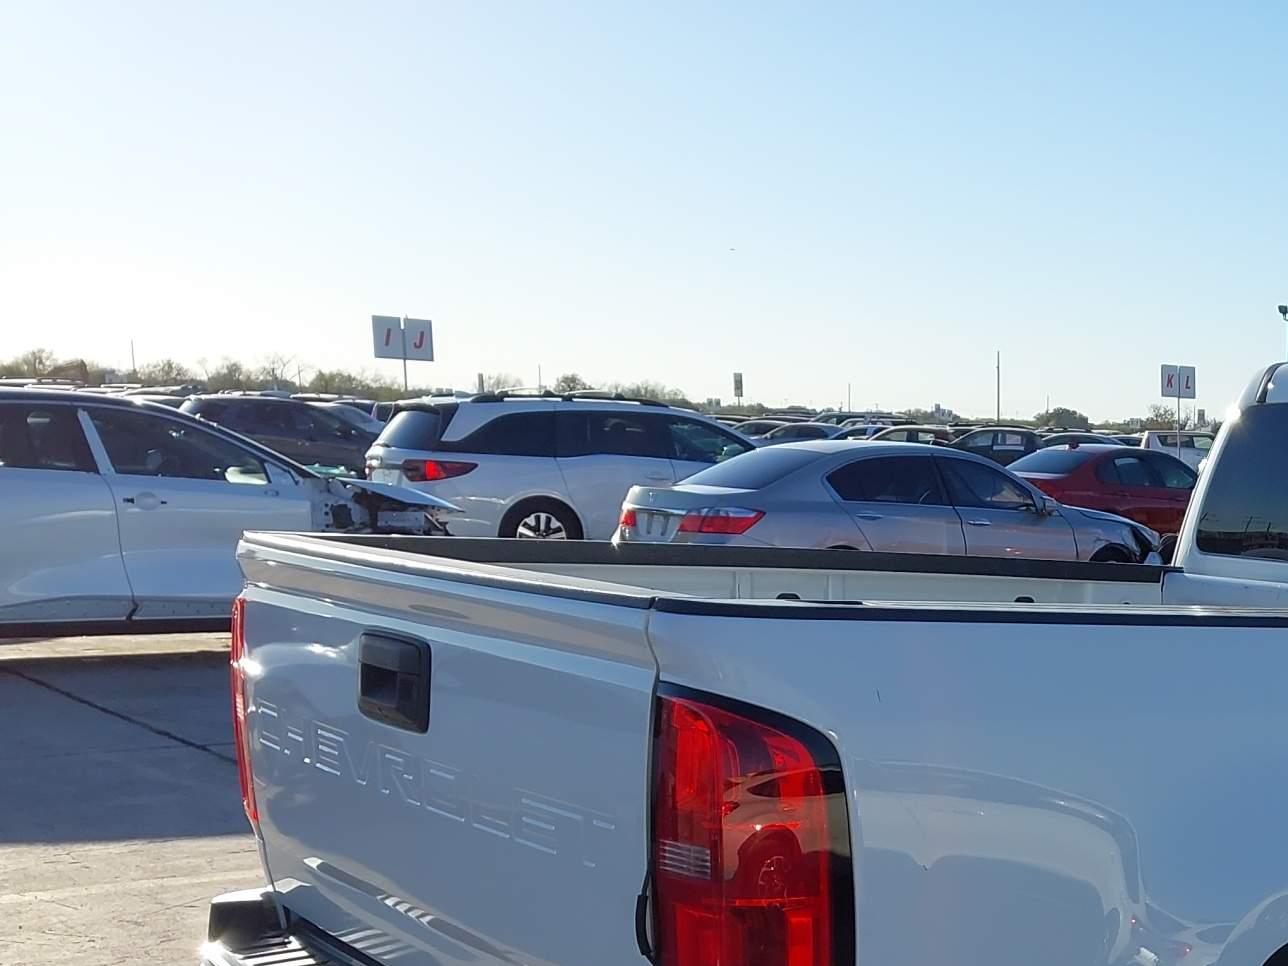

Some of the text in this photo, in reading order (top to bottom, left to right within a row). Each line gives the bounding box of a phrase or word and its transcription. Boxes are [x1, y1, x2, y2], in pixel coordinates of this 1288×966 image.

[385, 328, 425, 349] I J
[1167, 373, 1191, 389] K L
[253, 697, 616, 868] CHEVROLET
